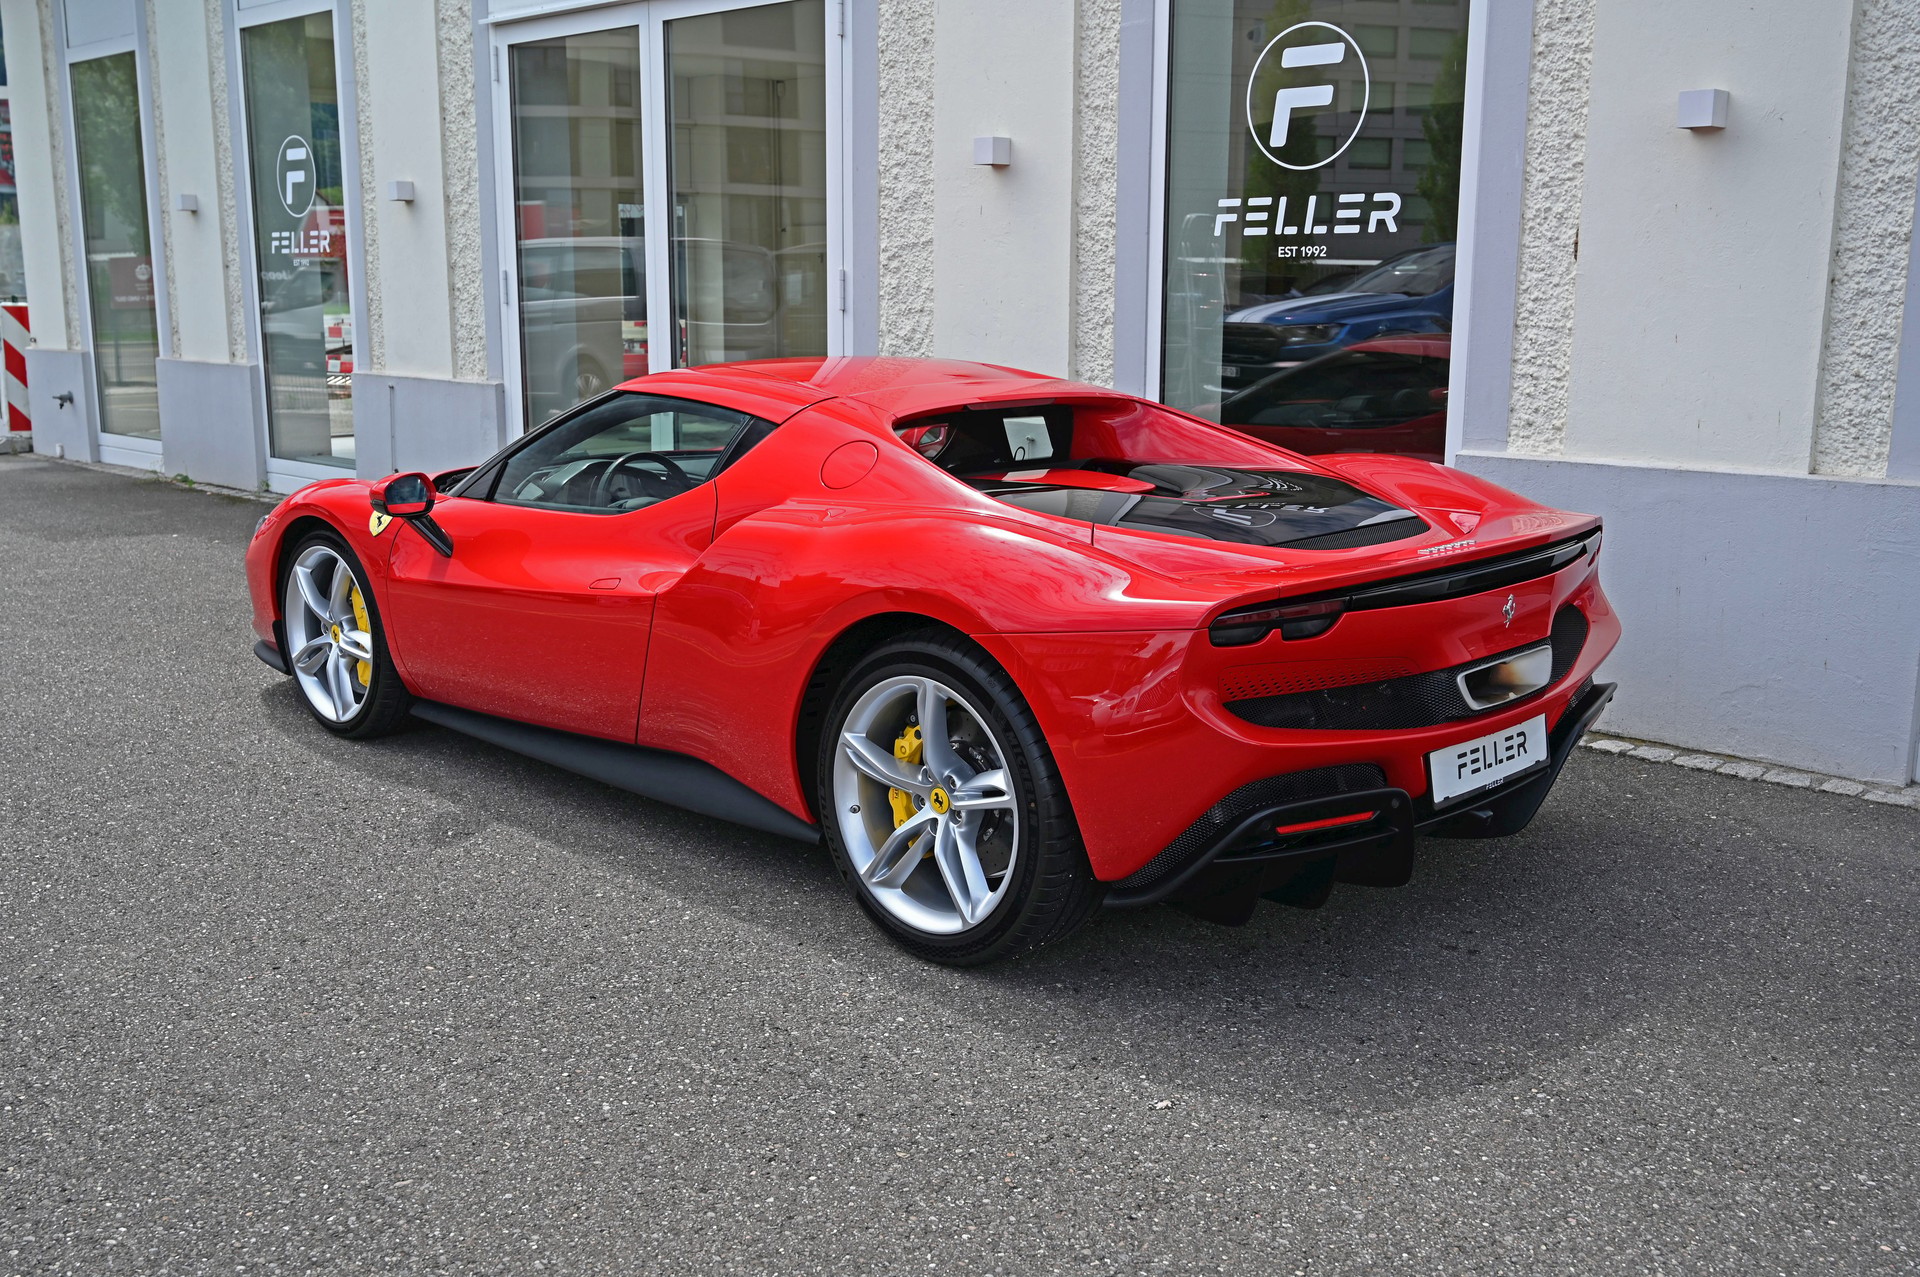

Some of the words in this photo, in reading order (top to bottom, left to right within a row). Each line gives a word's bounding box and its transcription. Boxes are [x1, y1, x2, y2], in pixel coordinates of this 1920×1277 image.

[1213, 192, 1402, 236] FELLER
[271, 230, 331, 254] FELLER
[1278, 246, 1298, 258] EST
[1301, 245, 1327, 257] 1992
[1457, 730, 1528, 780] FELLER
